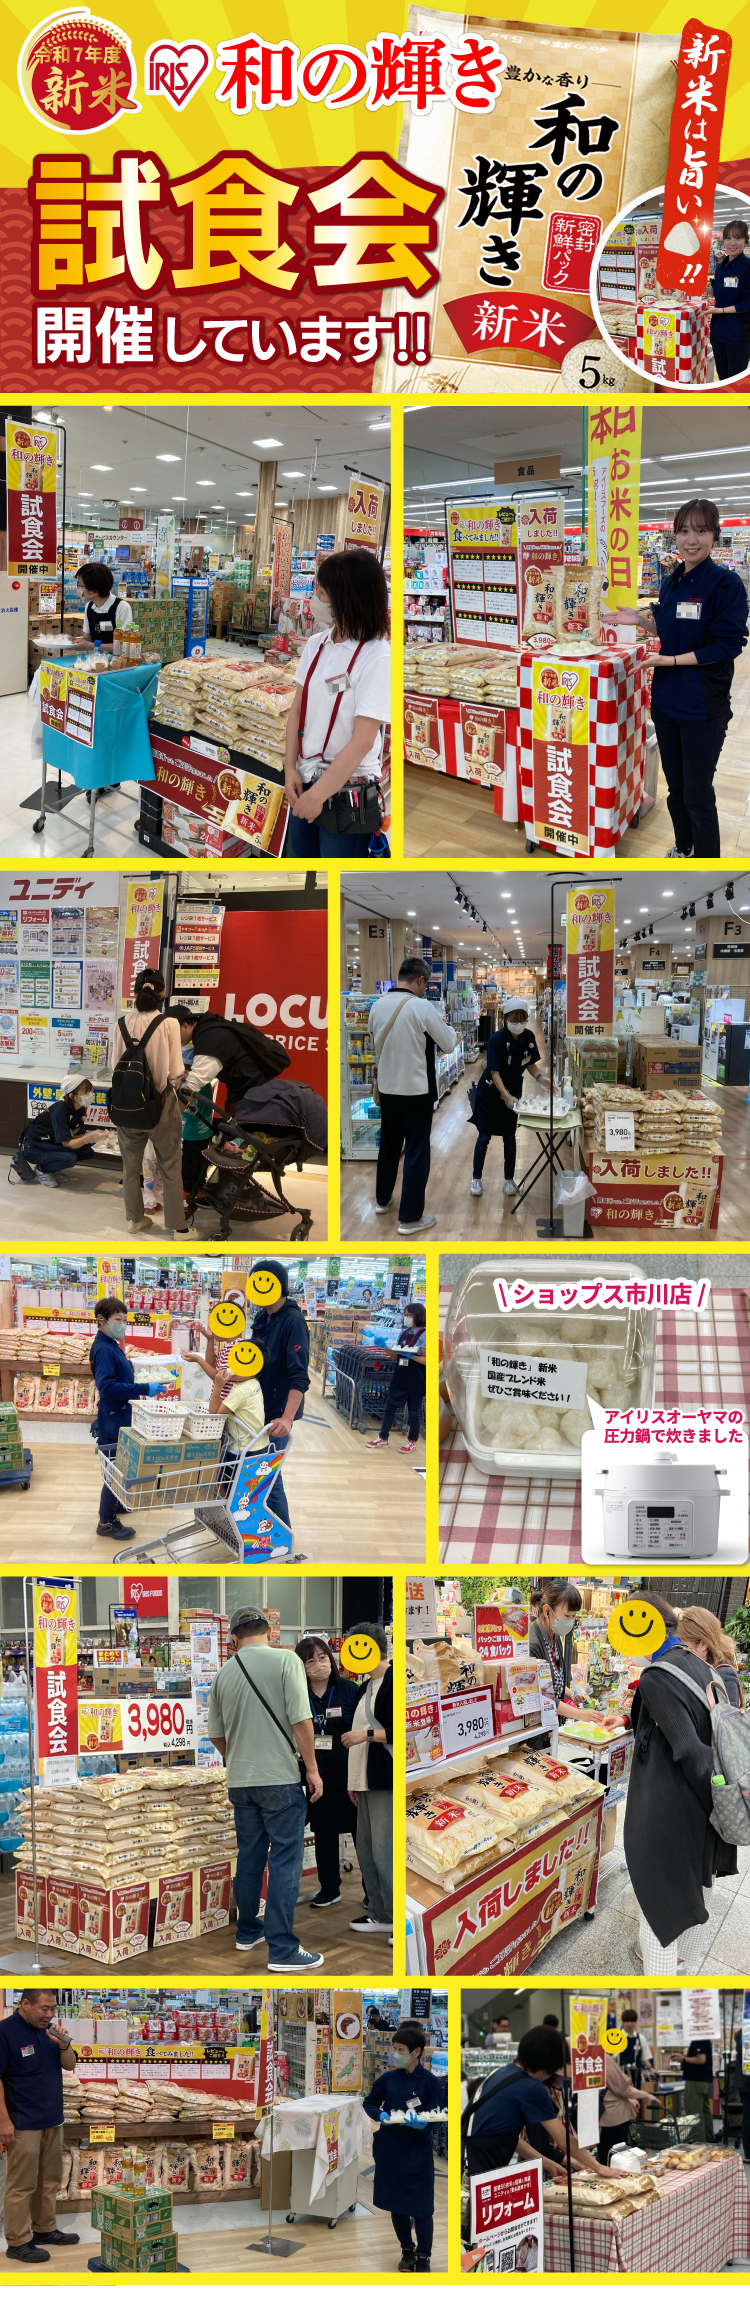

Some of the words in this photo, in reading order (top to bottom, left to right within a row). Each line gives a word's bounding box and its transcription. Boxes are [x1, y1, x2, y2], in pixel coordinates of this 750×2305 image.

[504, 65, 589, 90] 豊かな香り
[575, 219, 597, 254] 密封
[552, 216, 574, 286] 新鮮パック
[471, 301, 567, 351] 新米
[578, 355, 616, 390] 5kg
[10, 448, 54, 467] 和の輝き
[517, 465, 535, 476] 食品
[354, 489, 379, 519] 入荷
[467, 518, 501, 532] 和の輝き
[529, 507, 558, 525] 入荷
[609, 448, 632, 588] お米の日
[21, 494, 44, 561] 試食会
[453, 528, 499, 543] 食べてみました!!
[18, 563, 49, 575] 開催中
[536, 689, 587, 712] 和の輝き
[42, 700, 64, 722] 試食会
[468, 765, 482, 777] 入荷
[156, 765, 207, 802] 和の輝き
[546, 744, 574, 829] 試食会
[544, 826, 579, 846] 開催中
[9, 877, 96, 901] ユニディ
[130, 902, 162, 914] 和の輝き
[570, 912, 613, 925] 和の輝き
[368, 925, 385, 938] E3
[723, 921, 742, 936] F3
[432, 949, 443, 958] E4
[649, 947, 661, 957] F4
[577, 956, 600, 1022] 試食会
[574, 1025, 605, 1036] 開催中
[599, 1157, 712, 1180] 入荷しました!!
[606, 1208, 655, 1221] 和の輝き
[486, 1356, 533, 1373] 「和の輝き」
[538, 1361, 557, 1374] 新米
[487, 1369, 547, 1387] 国産ブレンド米
[487, 1383, 571, 1403] ぜひご賞味ください!
[37, 1616, 76, 1633] 和の輝き
[46, 1670, 69, 1755] 試食会
[90, 1706, 118, 1718] 和の輝き
[127, 1702, 185, 1742] 3,980
[457, 1716, 485, 1737] 3,980
[505, 1784, 527, 1799] 新米
[434, 1810, 461, 1828] 新米
[452, 1820, 591, 1951] 入荷しました!!
[106, 2046, 142, 2057] 和の輝き
[575, 2056, 604, 2075] 試食会
[481, 2192, 536, 2227] リフォーム
